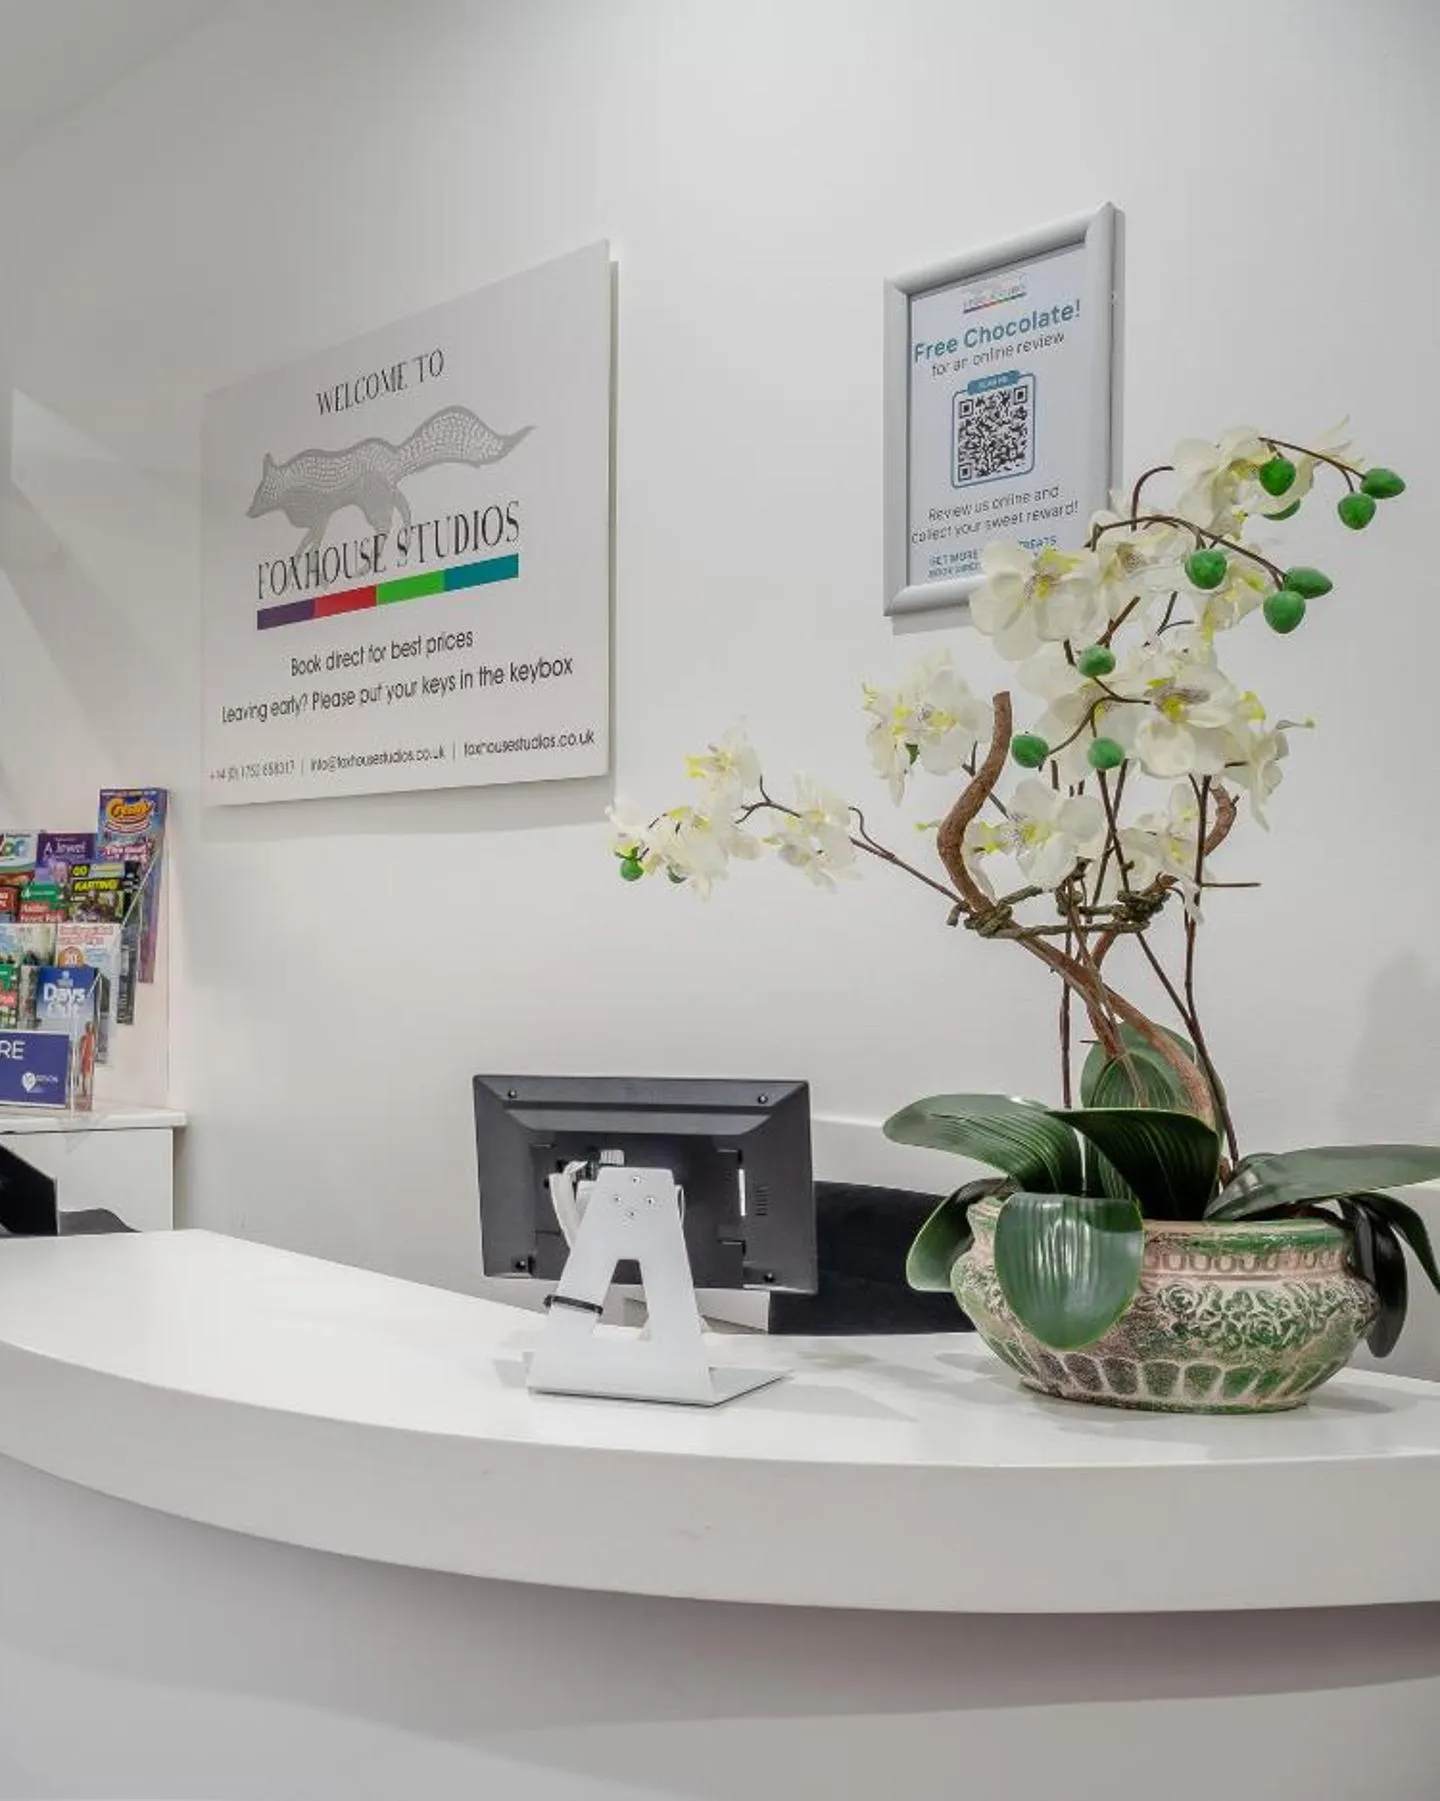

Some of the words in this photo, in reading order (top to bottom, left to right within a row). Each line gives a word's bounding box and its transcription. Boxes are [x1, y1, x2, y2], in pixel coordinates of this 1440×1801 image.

[914, 337, 958, 362] Free
[964, 298, 1081, 350] Chocolate!
[931, 361, 951, 378] for
[972, 343, 1014, 367] online
[1016, 331, 1065, 354] review
[316, 361, 408, 416] WELCOME
[410, 348, 444, 383] TO
[911, 527, 952, 544] collect
[955, 521, 982, 538] your
[984, 511, 1024, 532] sweet
[1026, 500, 1079, 524] reward!
[928, 506, 973, 522] Review
[975, 500, 990, 515] us
[991, 492, 1031, 510] online
[1034, 486, 1060, 502] and
[258, 532, 389, 600] FOXHOUSE
[396, 500, 520, 568] STUDIOS
[290, 654, 322, 677] Book
[326, 645, 364, 671] direct
[368, 644, 387, 664] for
[391, 635, 422, 660] best
[426, 630, 474, 658] prices
[222, 702, 268, 723] Leaving
[270, 692, 309, 716] early?
[312, 689, 356, 711] Please
[359, 684, 383, 706] put
[385, 680, 418, 705] your
[422, 673, 456, 697] keys
[460, 668, 474, 690] in
[479, 665, 506, 687] the
[510, 656, 574, 684] keybox
[463, 728, 595, 758] foxhousestudios.co.uk
[72, 864, 88, 876] GO
[43, 982, 86, 1004] Days
